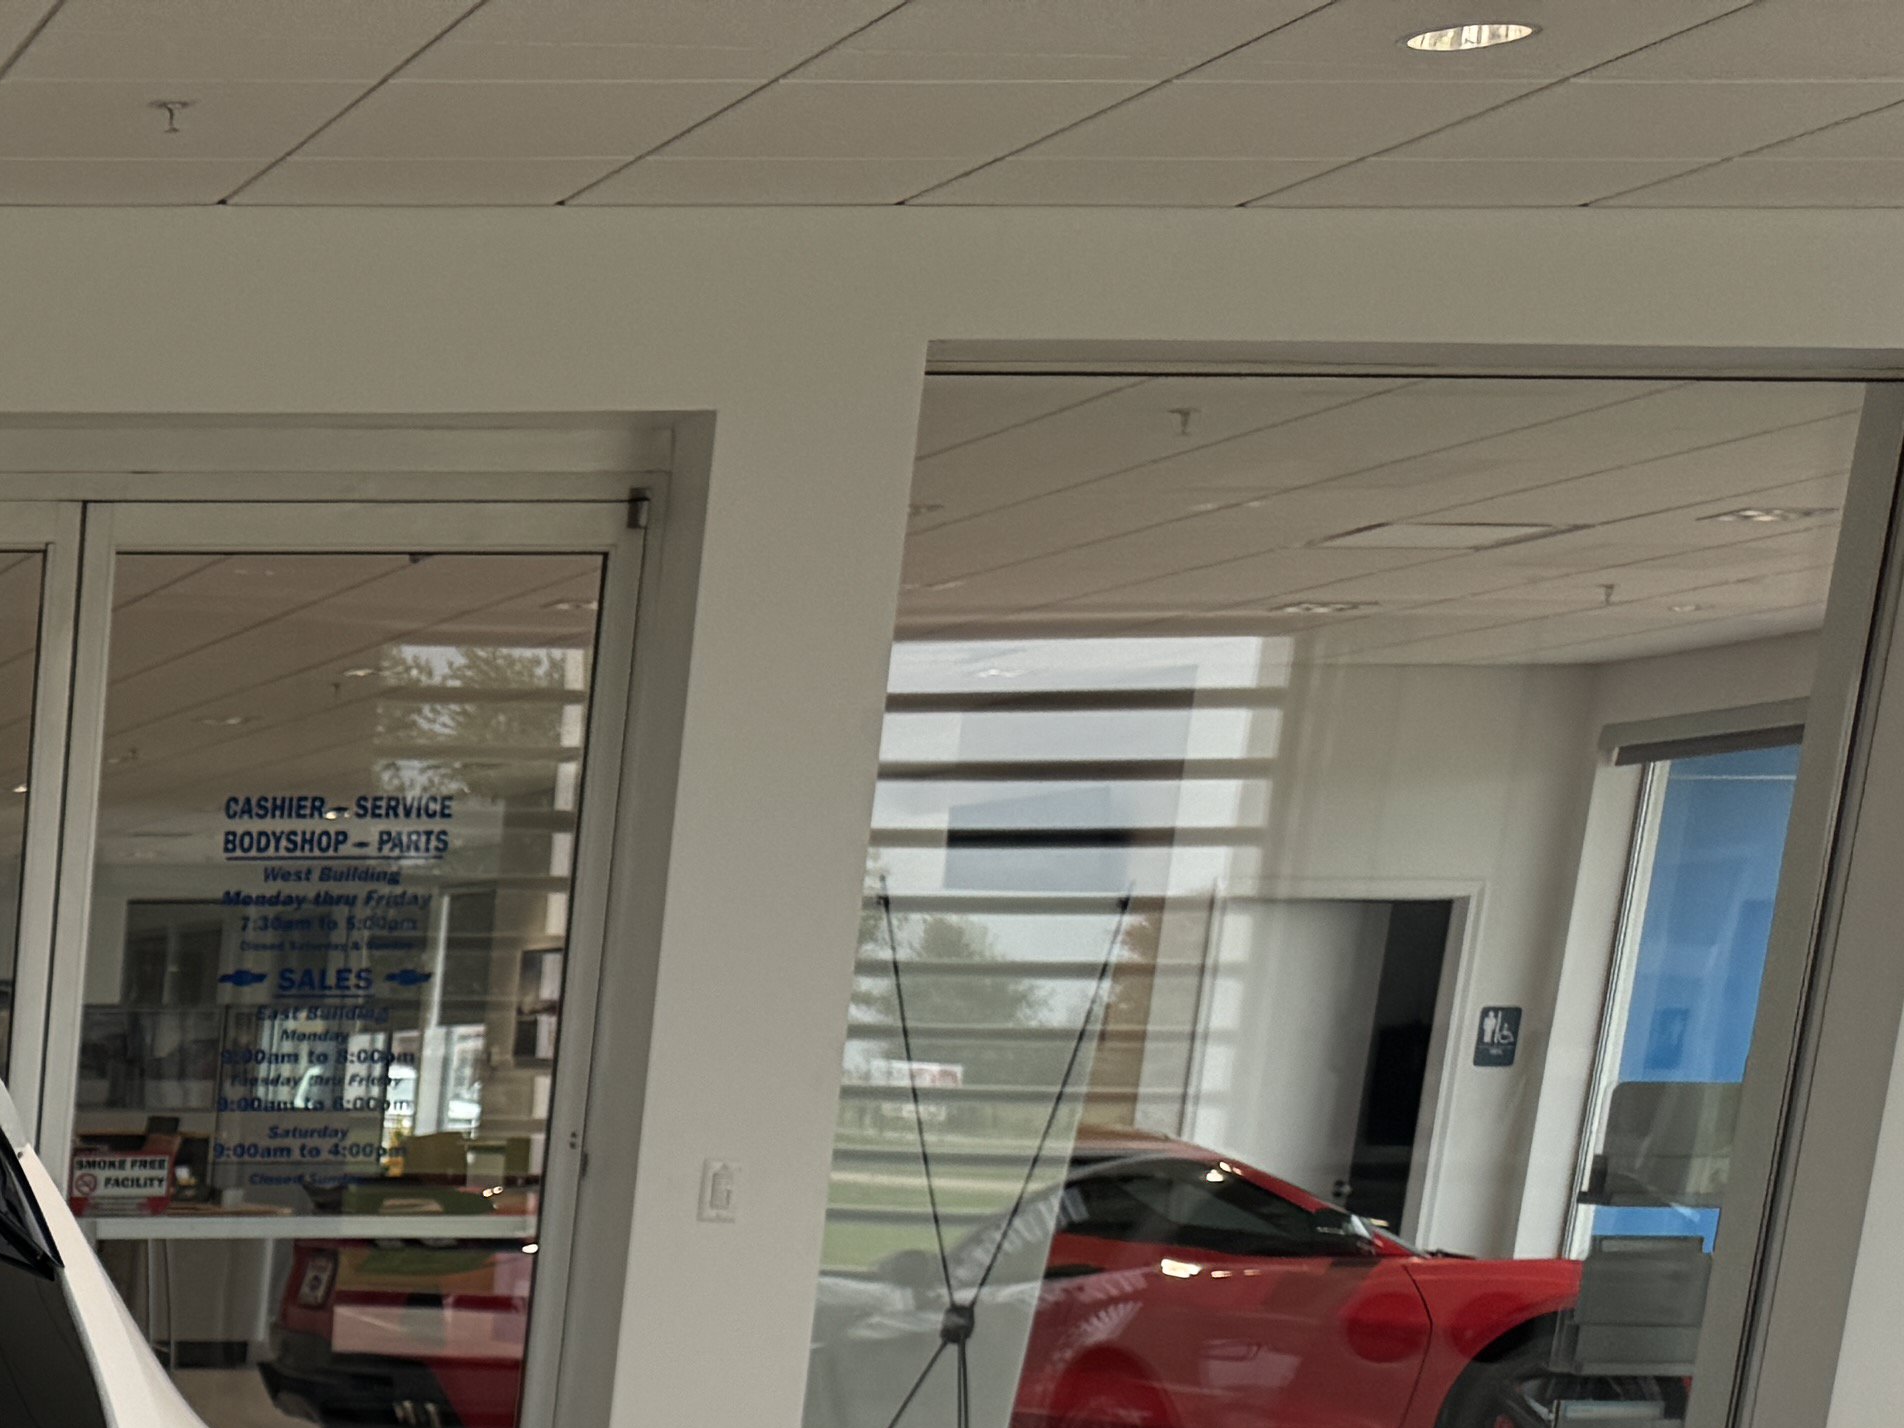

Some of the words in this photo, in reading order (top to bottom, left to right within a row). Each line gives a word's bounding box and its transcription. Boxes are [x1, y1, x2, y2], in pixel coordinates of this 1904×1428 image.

[225, 796, 326, 820] CASHIER
[354, 795, 454, 819] SERVICE
[223, 830, 348, 853] BODYSHOP
[377, 829, 449, 853] PARTS
[263, 866, 313, 883] West
[318, 866, 401, 885] Building
[222, 889, 308, 909] Monday
[314, 890, 359, 907] thru
[364, 889, 433, 909] Friday
[321, 916, 338, 931] to
[278, 968, 373, 992] SALES
[257, 1005, 303, 1021] East
[280, 1029, 350, 1045] Monday
[308, 1050, 329, 1064] to
[267, 1125, 350, 1141] Saturday
[300, 1143, 321, 1158] to
[74, 1159, 128, 1170] SMOKE
[130, 1158, 167, 1170] FREE
[103, 1176, 165, 1188] FACILITY
